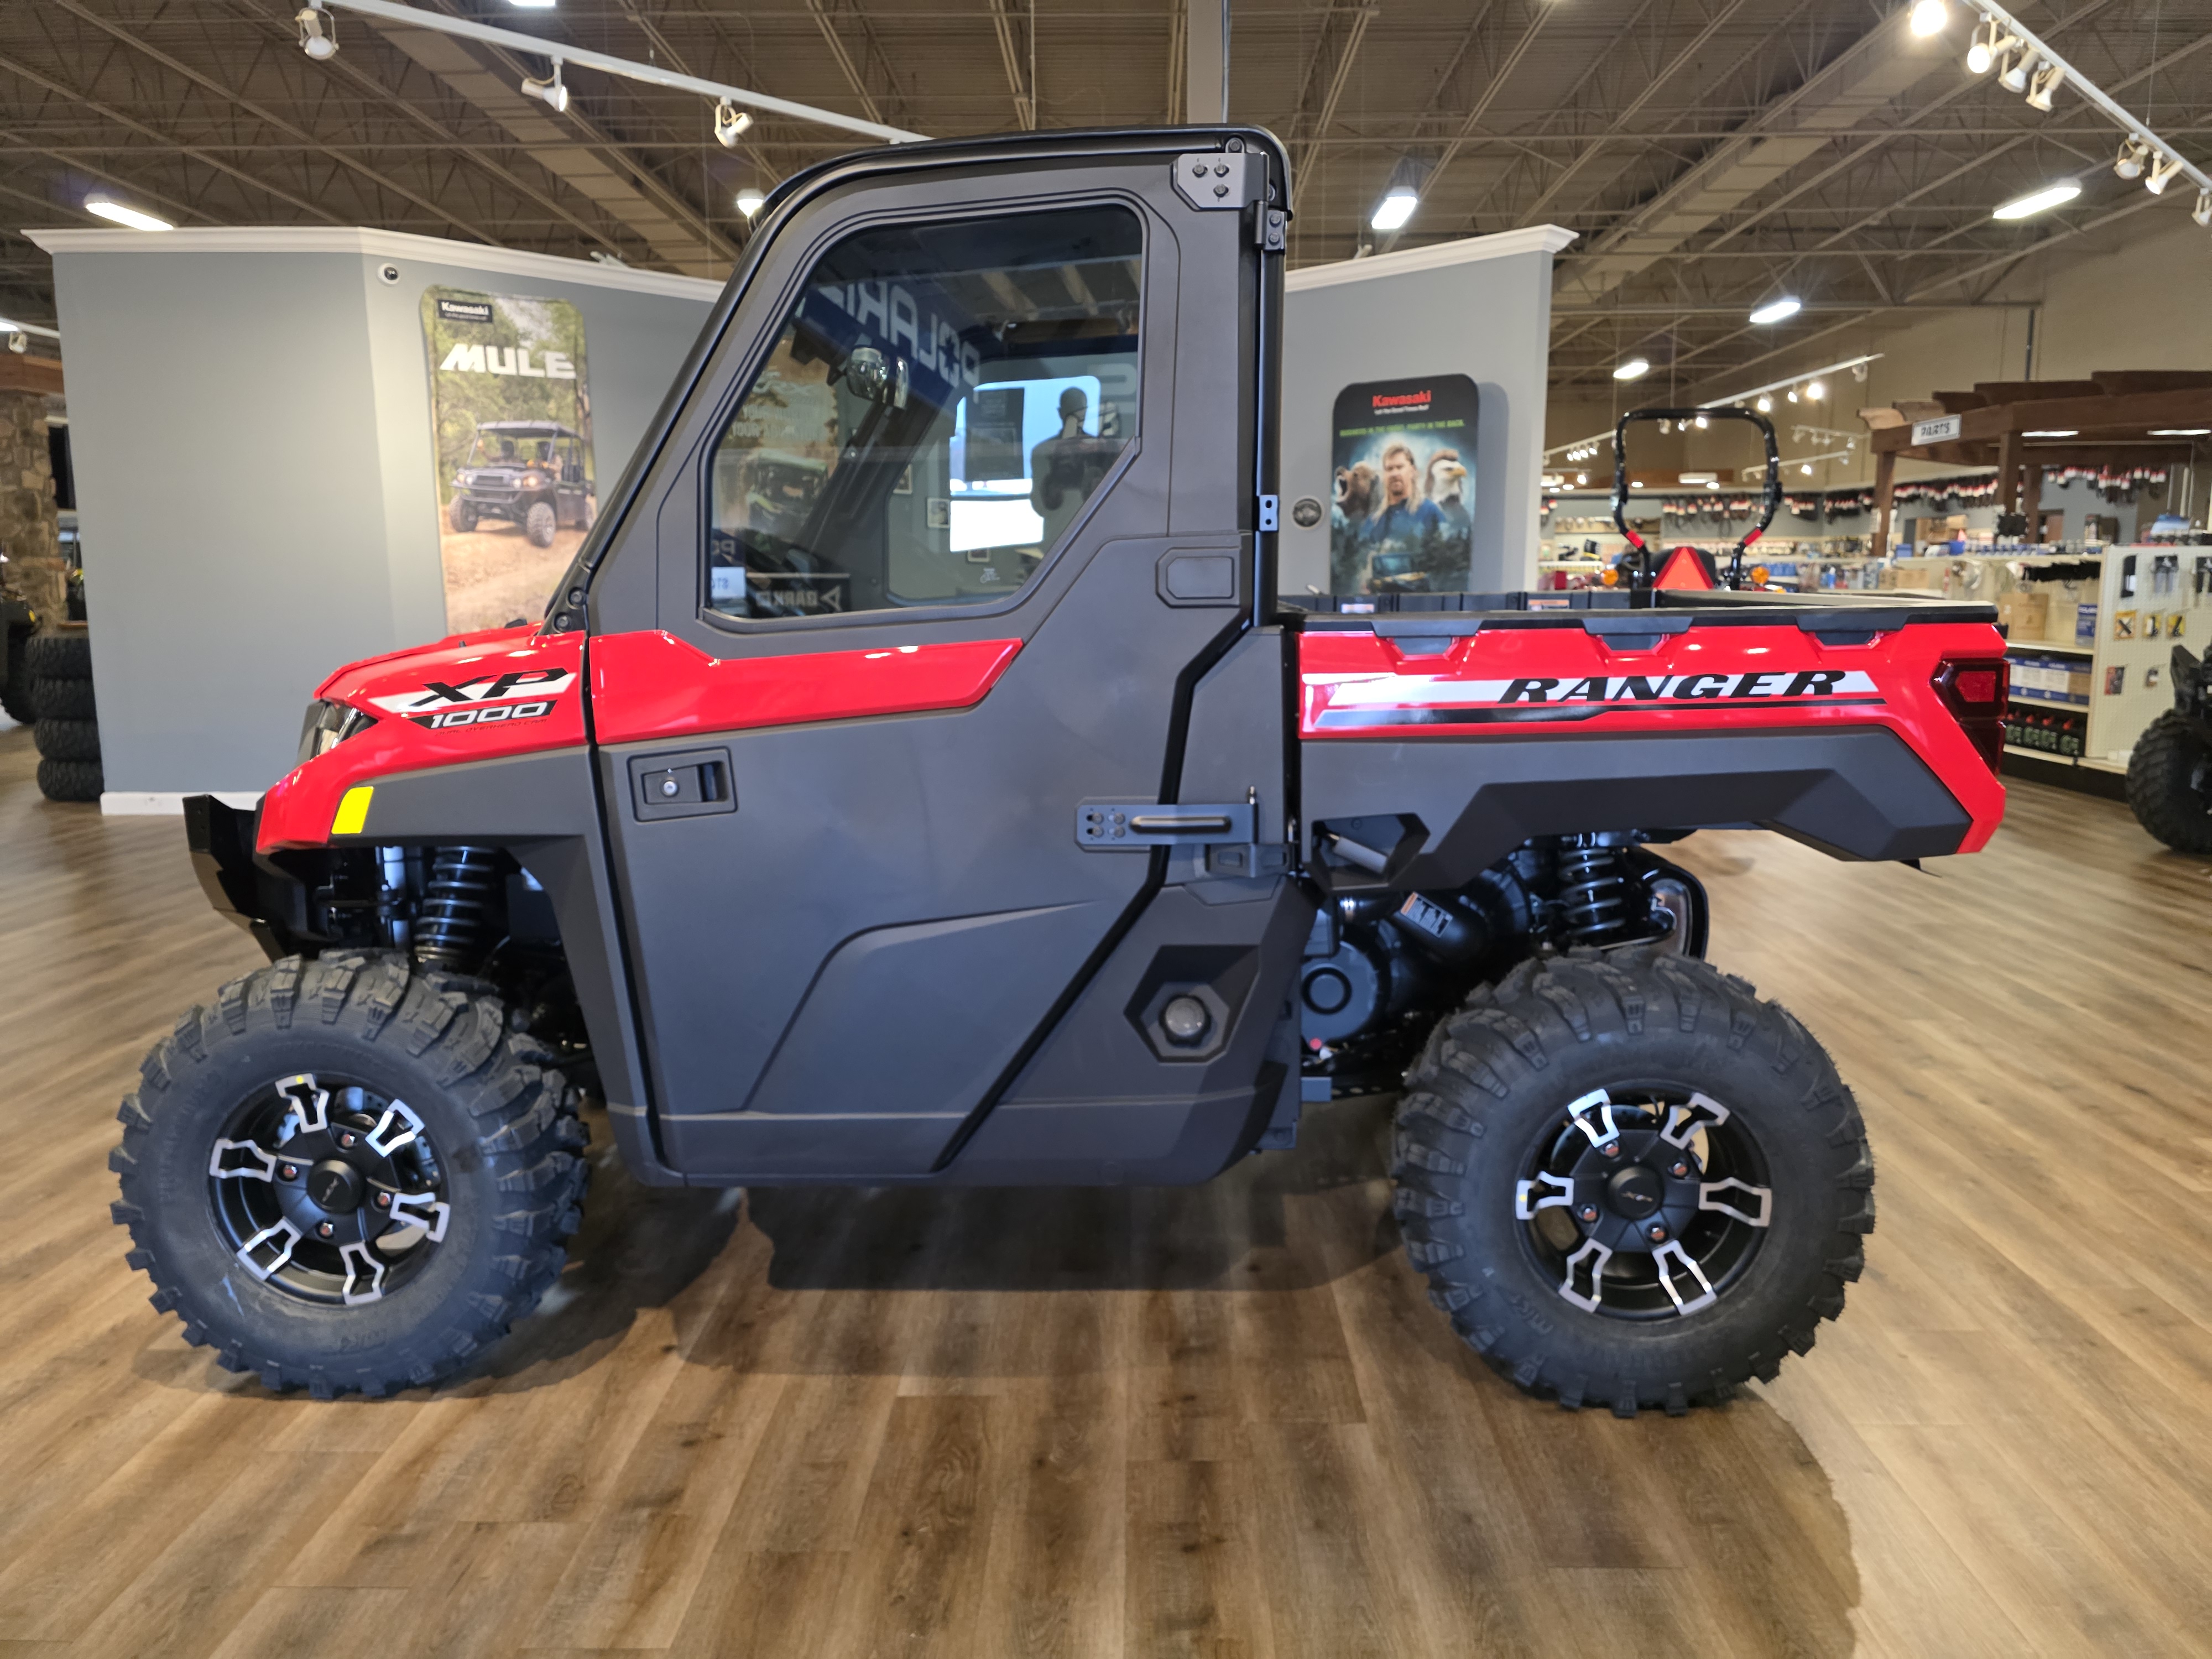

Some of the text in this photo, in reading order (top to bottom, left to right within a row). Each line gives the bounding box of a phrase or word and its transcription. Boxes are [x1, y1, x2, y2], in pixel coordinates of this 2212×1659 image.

[441, 301, 489, 316] Kawasaki
[440, 343, 577, 379] MULE
[1372, 390, 1432, 408] Kawasaki
[1921, 422, 1950, 437] PARTS
[409, 667, 568, 707] XP
[1496, 670, 1846, 705] RANGER
[431, 701, 548, 728] 1000
[466, 722, 521, 733] OVERHEAD
